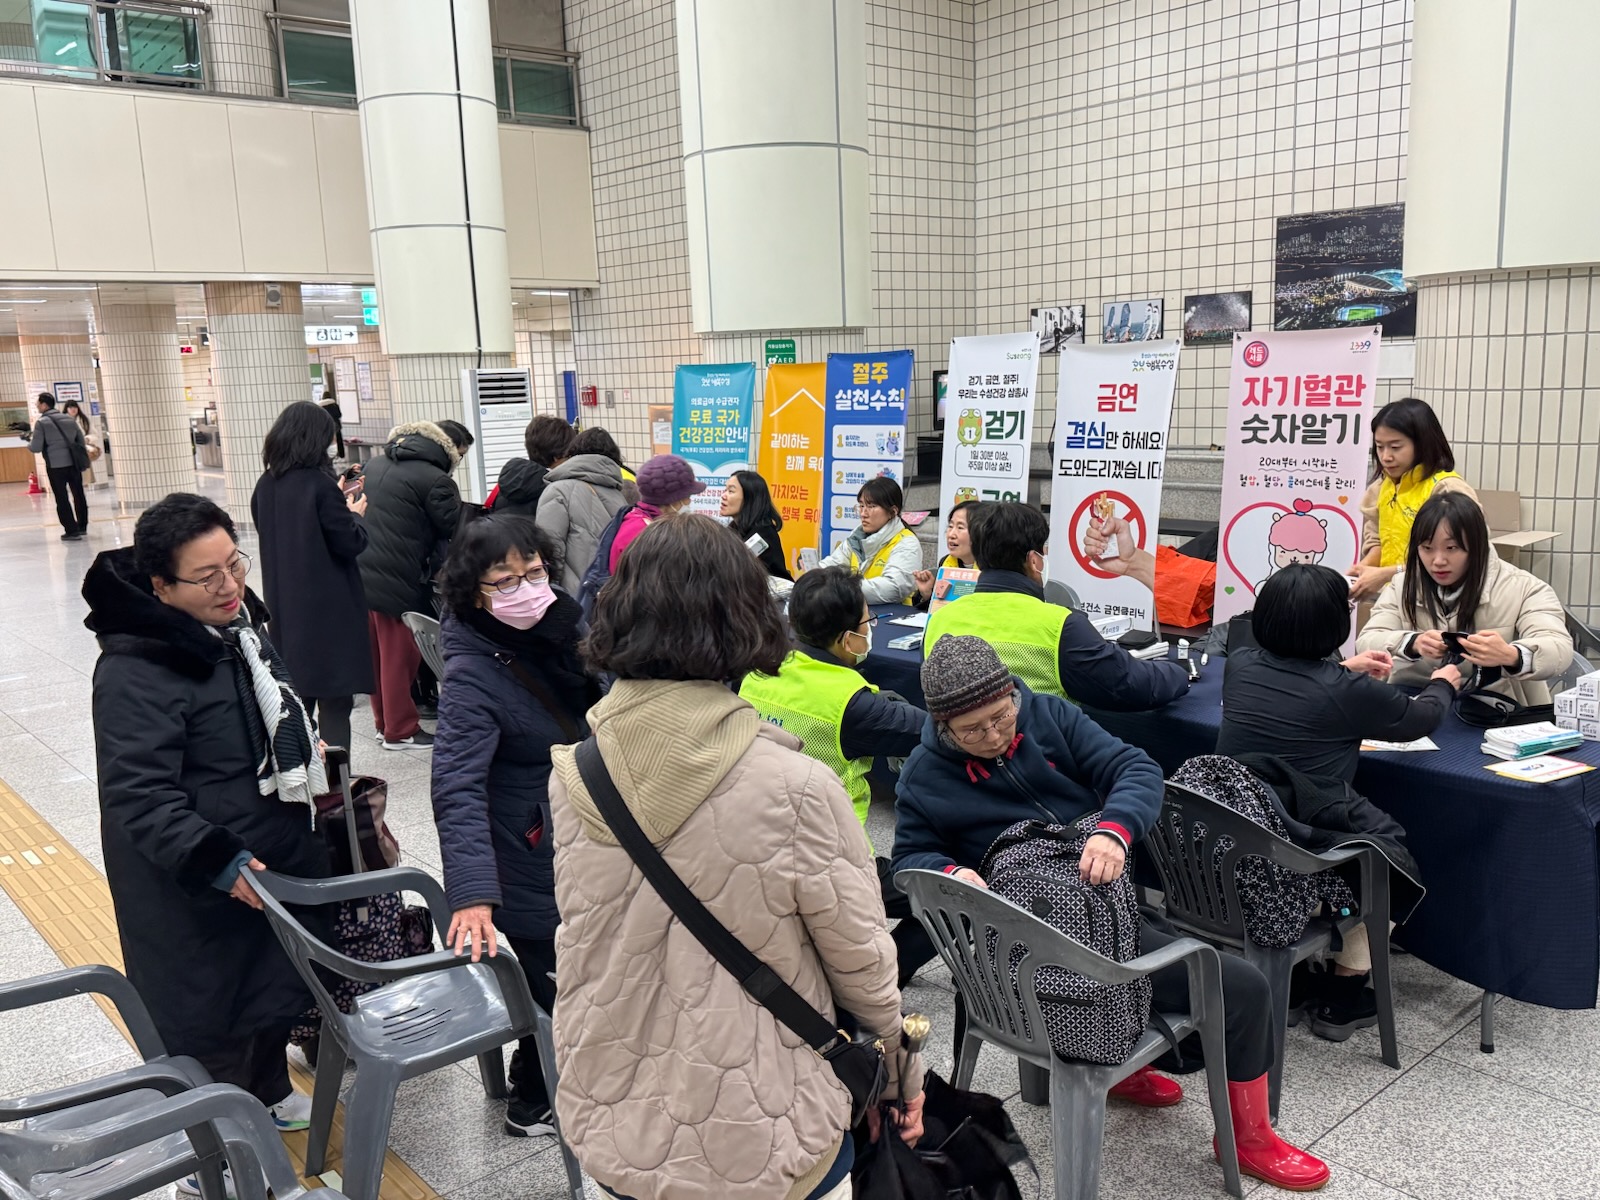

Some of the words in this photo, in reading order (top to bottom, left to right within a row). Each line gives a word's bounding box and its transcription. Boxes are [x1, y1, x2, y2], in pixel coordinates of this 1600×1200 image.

[1350, 340, 1371, 350] 1339
[853, 362, 888, 384] 절주
[968, 376, 983, 386] 걷기,
[1003, 374, 1019, 385] 절주!
[958, 389, 978, 400] 우리는
[980, 388, 1006, 399] 수성건강
[1008, 388, 1028, 398] 삼총사
[1242, 374, 1366, 406] 자기혈관
[690, 397, 714, 406] 의료급여
[716, 396, 740, 406] 수급권자
[834, 388, 905, 411] 실천수칙
[1097, 384, 1138, 412] 금연
[690, 410, 712, 426] 무료
[716, 409, 740, 426] 국가
[985, 410, 1026, 440] 걷기
[679, 427, 748, 444] 건강검진안내
[968, 430, 972, 439] 1
[1066, 422, 1118, 450] 결심만
[1122, 430, 1164, 450] 하세요!
[1240, 414, 1360, 444] 숫자알기
[770, 433, 810, 448] 같이하는
[836, 434, 844, 448] 1
[970, 450, 978, 460] 1일
[980, 450, 993, 460] 30분
[1260, 456, 1297, 468] 20대부터
[1302, 458, 1338, 469] 시작하는
[786, 456, 804, 471] 함께
[968, 461, 983, 471] 주5일
[985, 462, 998, 471] 이상
[999, 462, 1012, 472] 실천
[836, 471, 844, 484] 2
[1240, 474, 1260, 487] 혈압,
[1264, 474, 1283, 488] 혈당,
[1335, 477, 1356, 490] 관리!
[770, 484, 808, 500] 가치있는
[782, 506, 800, 522] 행복
[836, 506, 842, 519] 3
[1104, 604, 1145, 619] 금연클리닉
